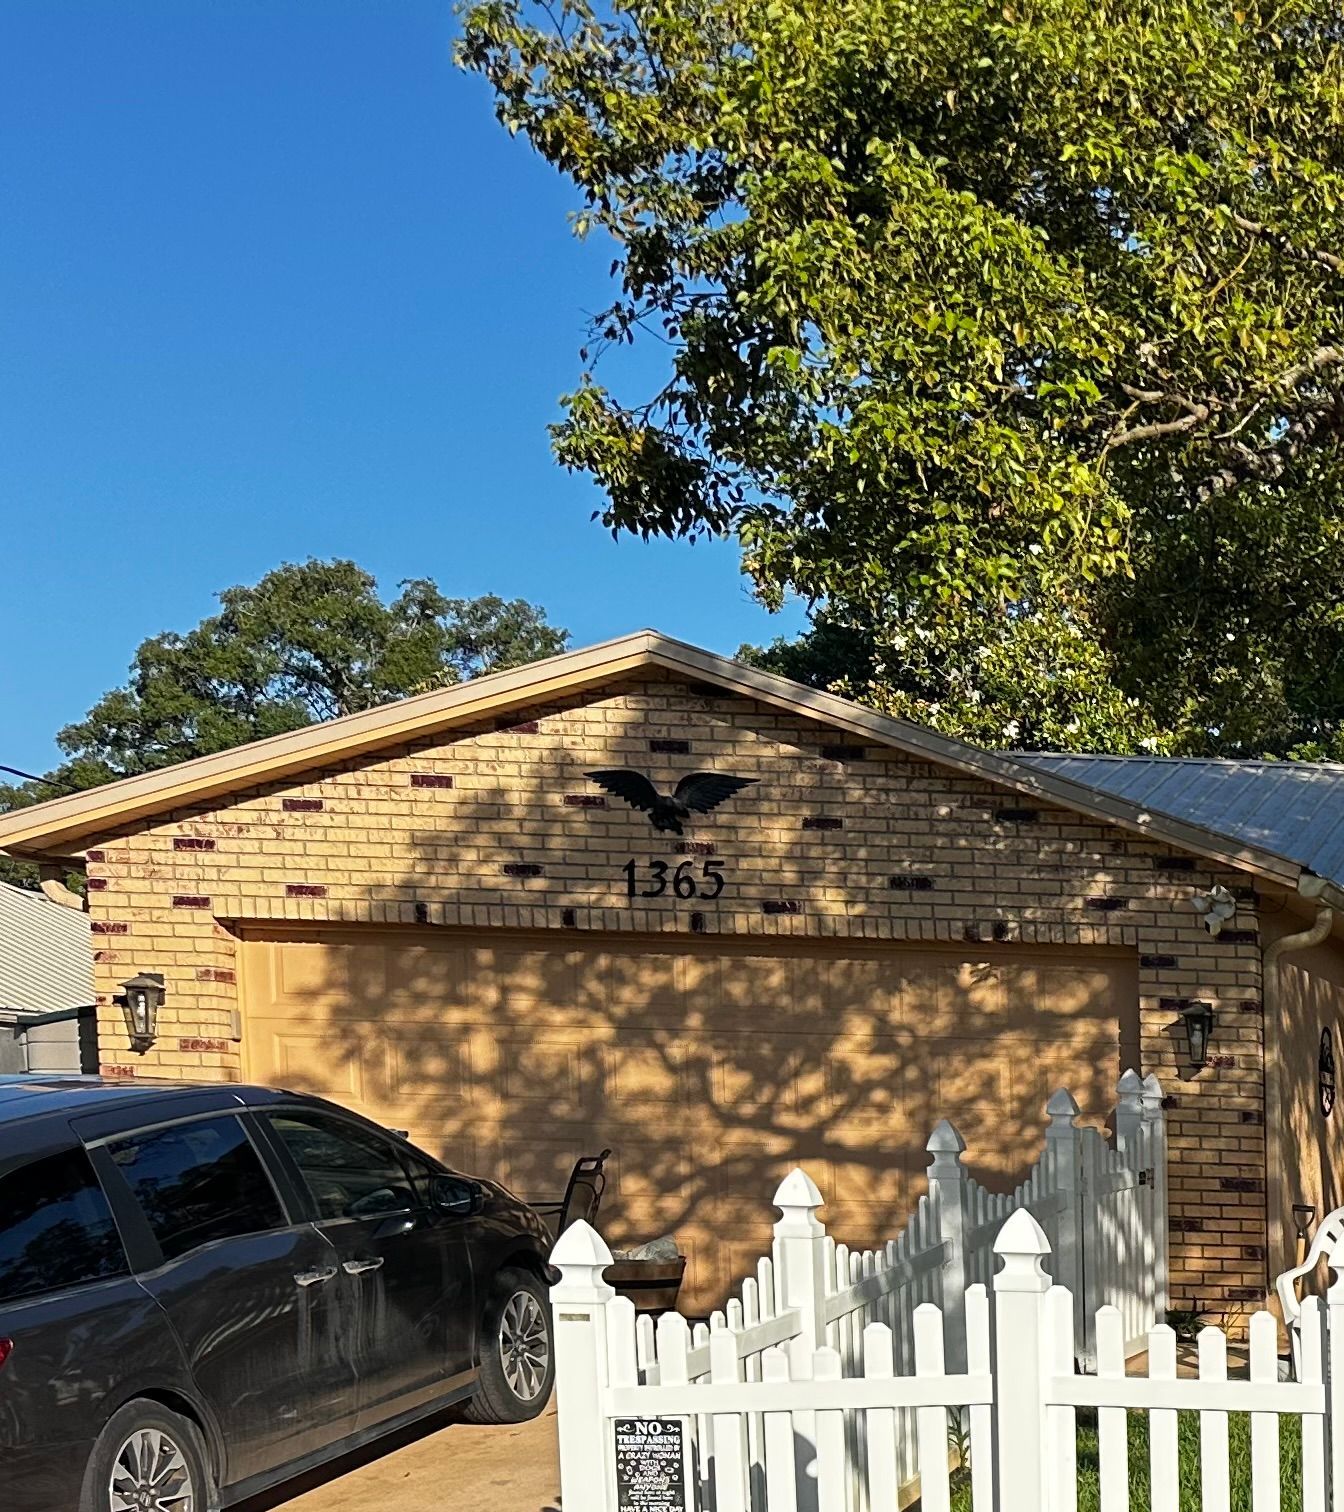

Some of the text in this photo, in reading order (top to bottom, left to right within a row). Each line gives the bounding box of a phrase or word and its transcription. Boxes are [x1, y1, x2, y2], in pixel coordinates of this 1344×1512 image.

[623, 858, 724, 900] 1365
[635, 1421, 662, 1435] NO
[617, 1435, 680, 1444] TRESPASSING
